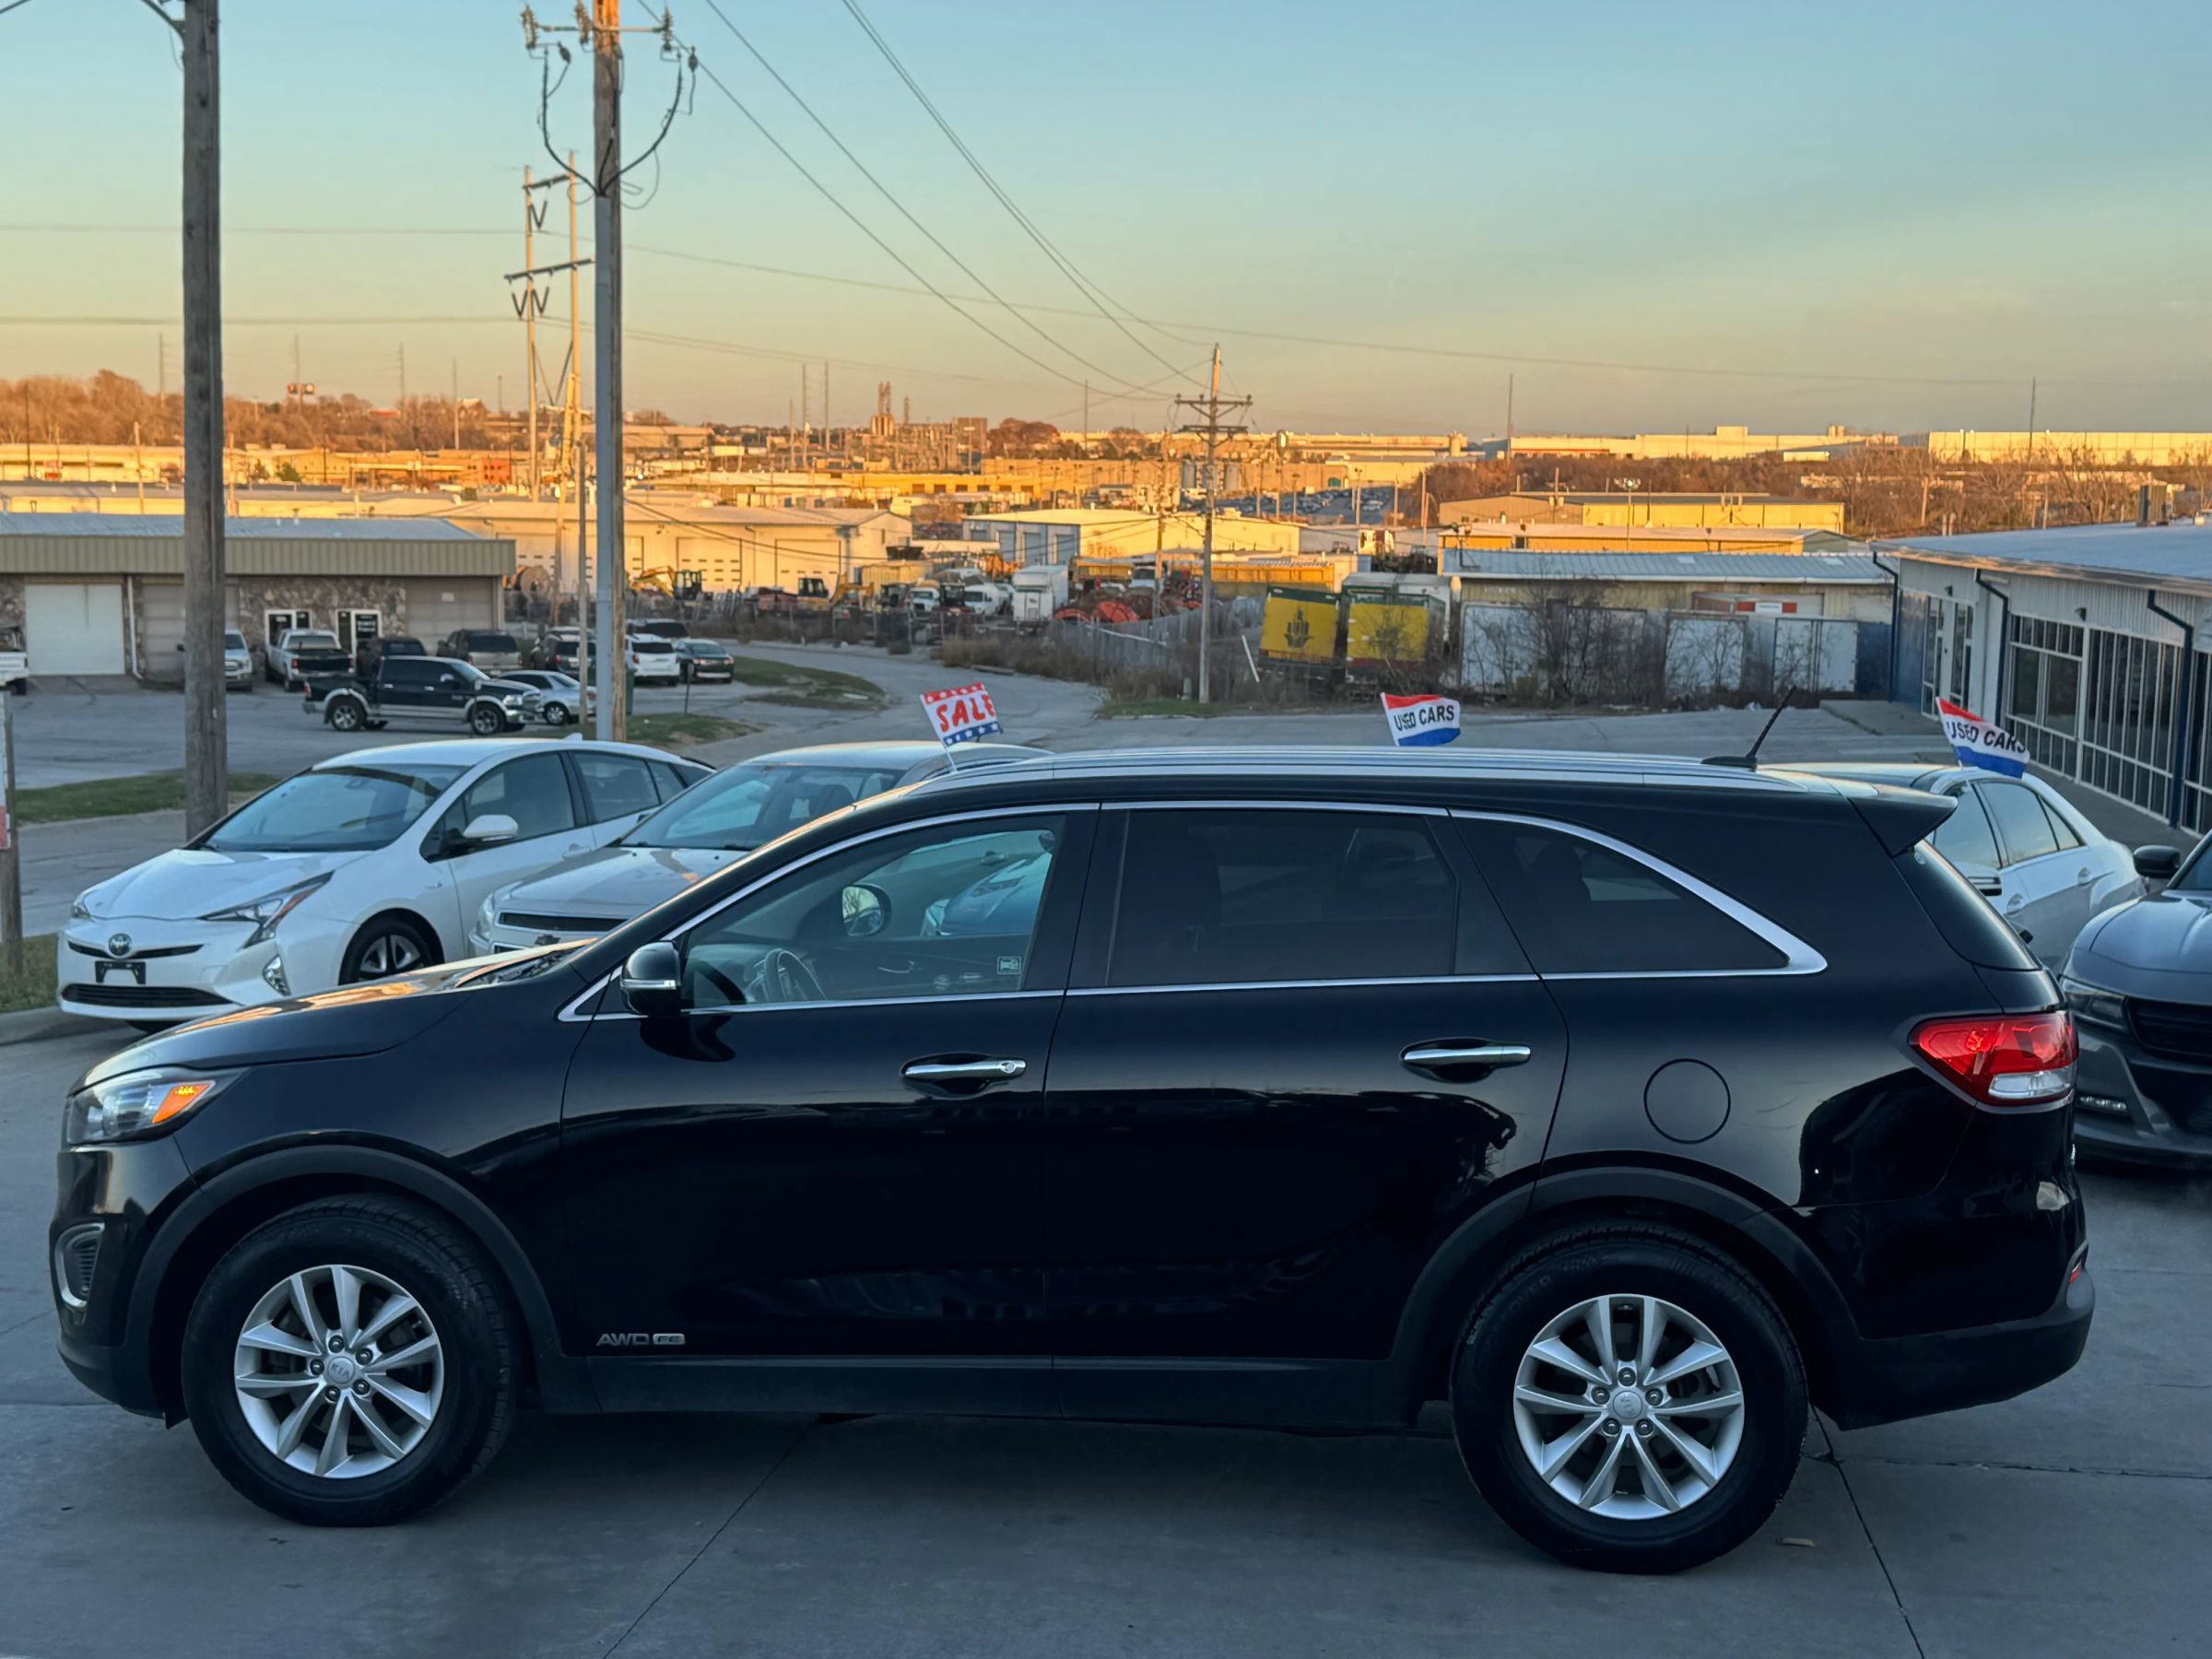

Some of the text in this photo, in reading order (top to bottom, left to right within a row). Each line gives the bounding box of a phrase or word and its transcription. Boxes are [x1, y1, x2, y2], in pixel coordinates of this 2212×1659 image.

[1394, 705, 1454, 732] USED CARS
[1947, 721, 1979, 744] USED
[595, 1333, 650, 1347] AWD
[330, 1362, 350, 1380] KIA
